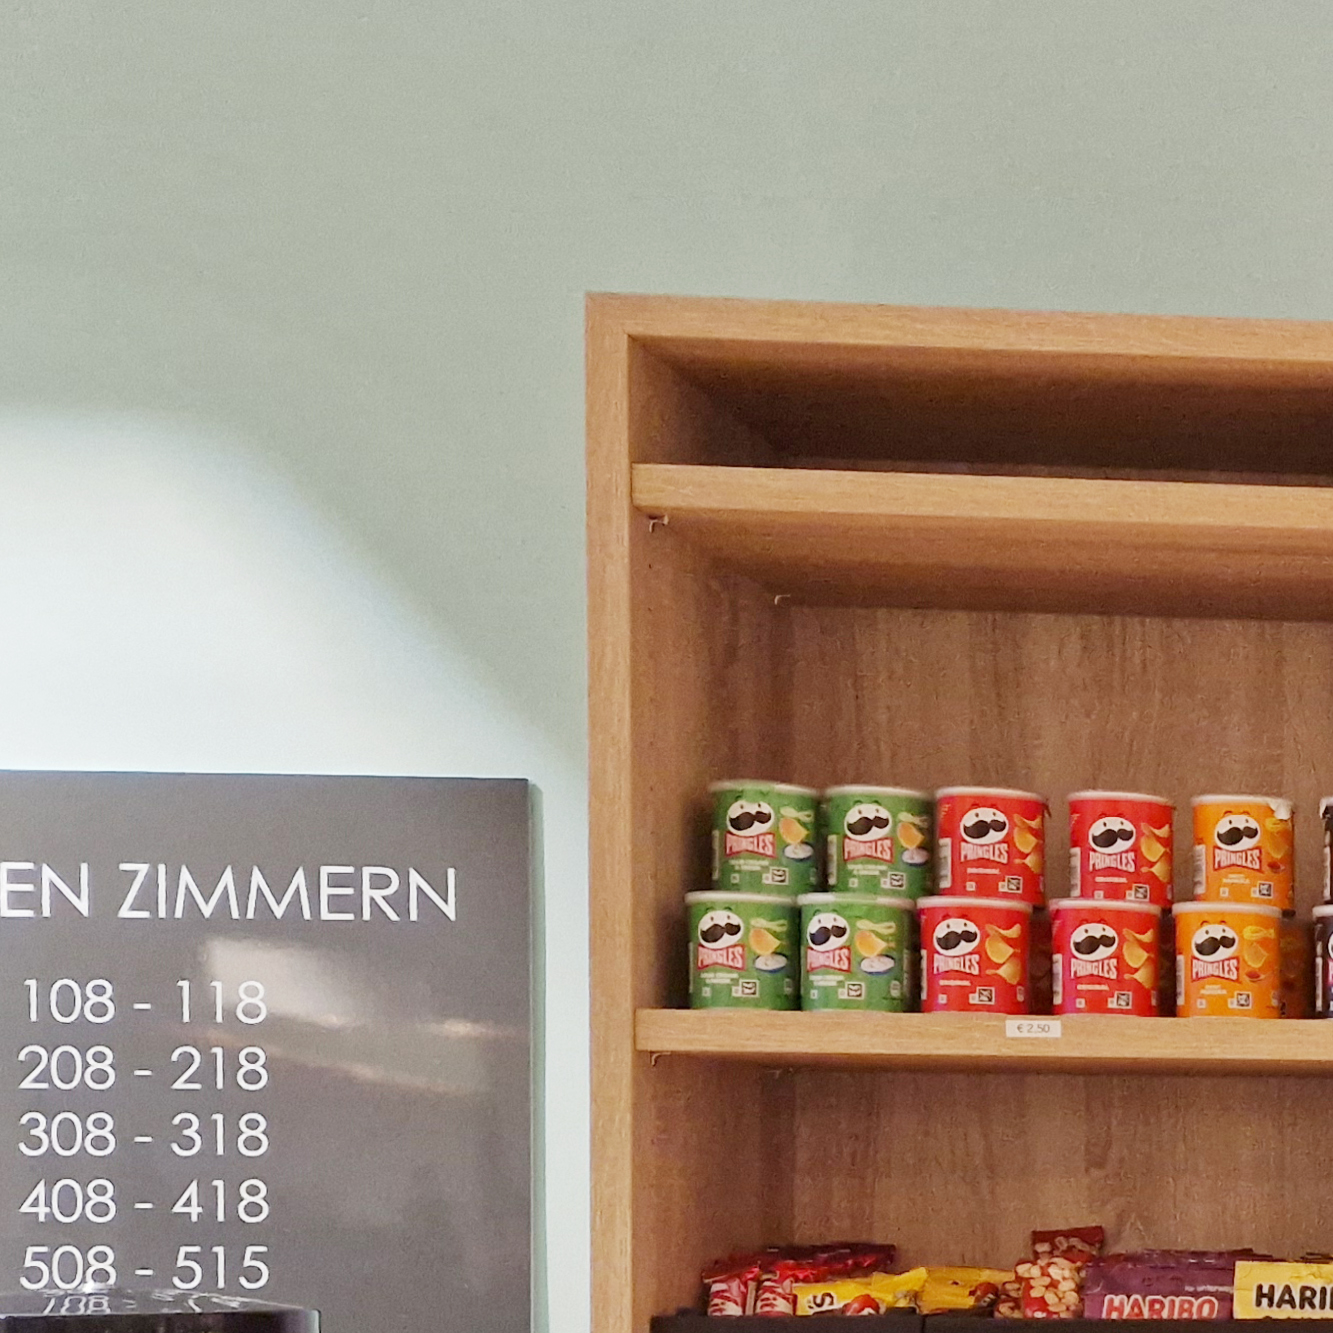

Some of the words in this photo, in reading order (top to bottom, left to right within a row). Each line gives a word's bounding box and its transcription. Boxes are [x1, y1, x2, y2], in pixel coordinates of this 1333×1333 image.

[726, 833, 775, 857] PRINGLES
[844, 837, 893, 862] PRINGLES
[960, 842, 1008, 865] PRINGLES
[1089, 850, 1135, 873] PRINGLES
[1214, 848, 1261, 870] PRINGLES
[117, 863, 458, 921] ZIMMERN
[697, 946, 745, 970] PRINGLES
[806, 947, 850, 972] PRINGLES
[933, 953, 980, 976] PRINGLES
[1070, 958, 1117, 980] PRINGLES
[1192, 958, 1239, 981] PRINGLES
[24, 978, 115, 1024] 108
[175, 979, 268, 1025] 118
[17, 1044, 116, 1091] 208
[170, 1045, 269, 1091] 218
[17, 1111, 116, 1156] 308
[170, 1112, 270, 1157] 318
[19, 1178, 117, 1223] 408
[171, 1178, 270, 1224] 418
[19, 1245, 117, 1290] 508
[172, 1246, 270, 1290] 515
[1102, 1295, 1219, 1319] HARIBO
